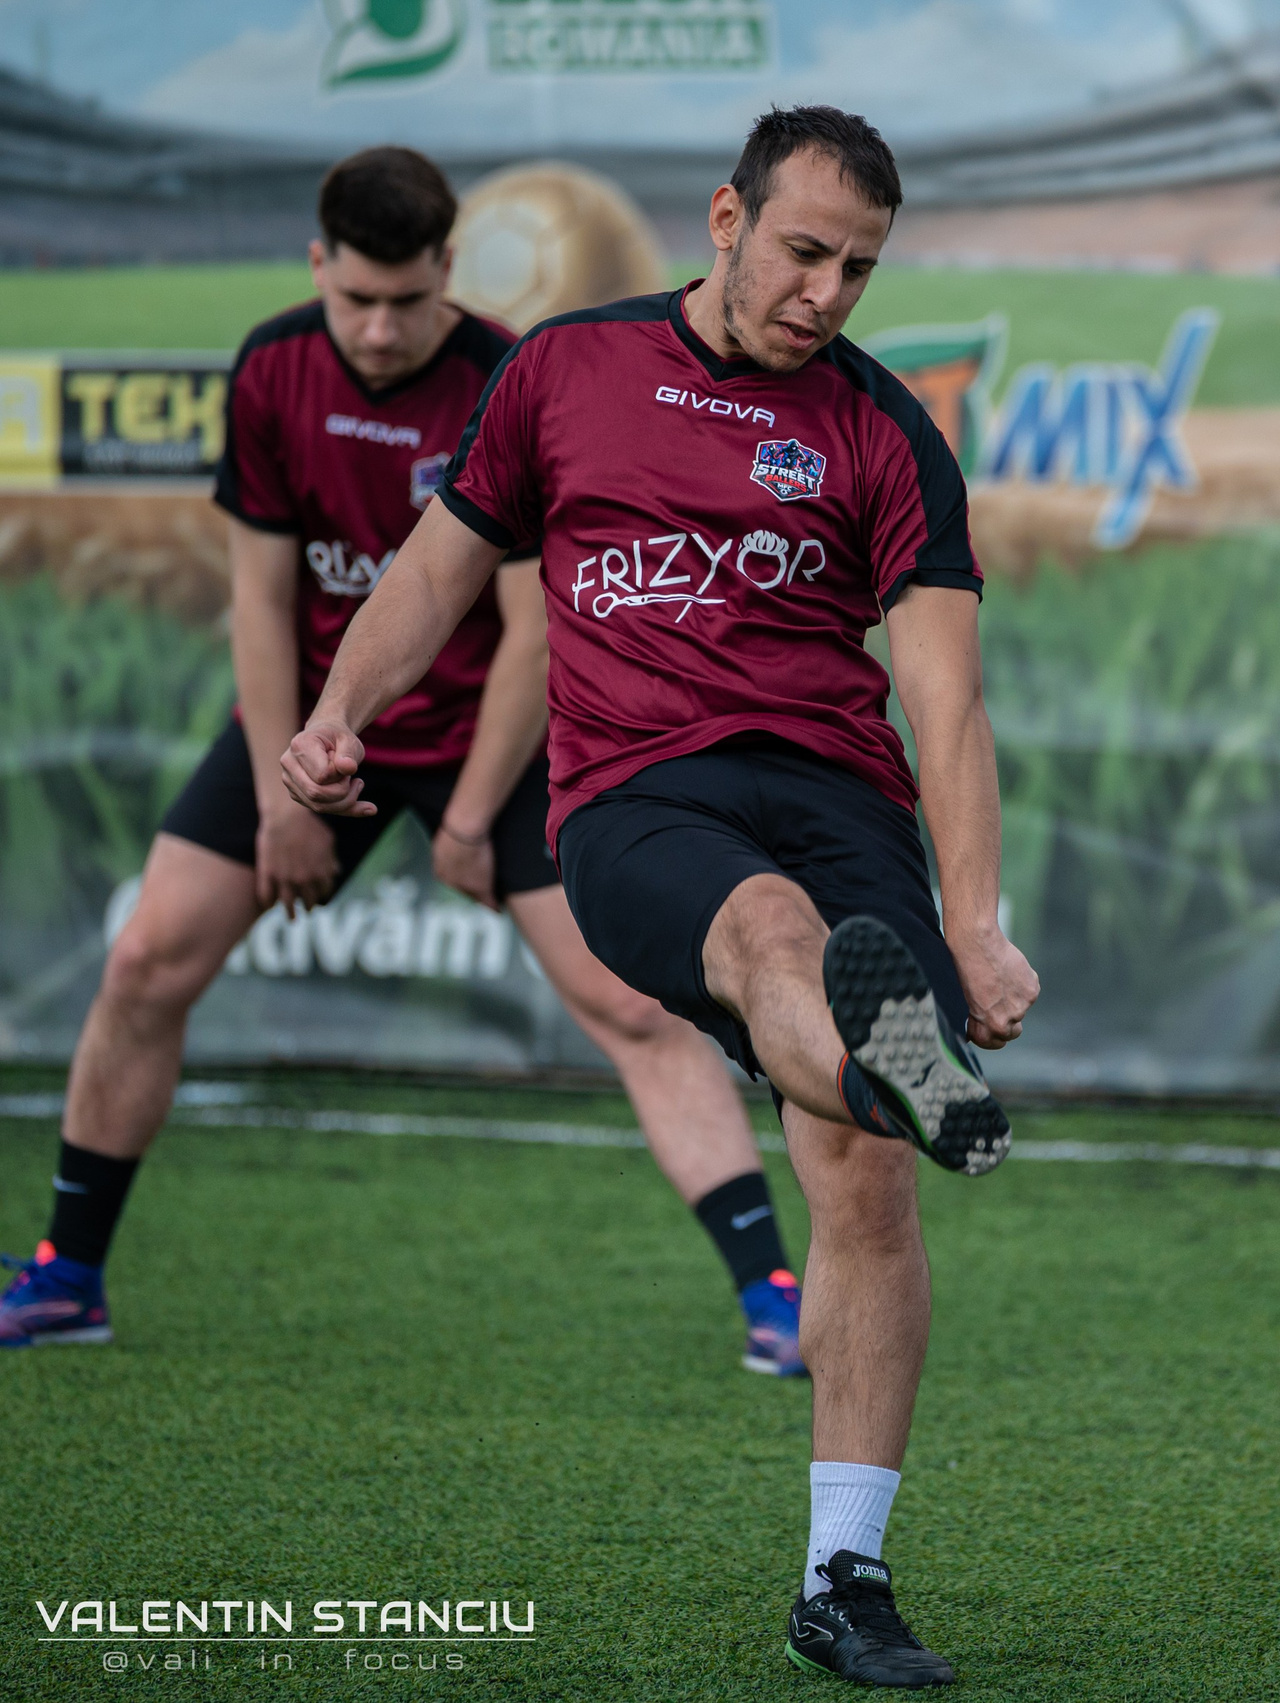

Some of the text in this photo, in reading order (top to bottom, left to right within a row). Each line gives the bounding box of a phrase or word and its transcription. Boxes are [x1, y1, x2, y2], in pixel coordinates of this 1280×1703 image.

[655, 386, 776, 428] GIVOVA
[754, 463, 816, 490] STREET
[764, 473, 807, 493] BALLERS
[572, 529, 826, 624] FRIZYOR
[852, 1563, 888, 1581] Joma
